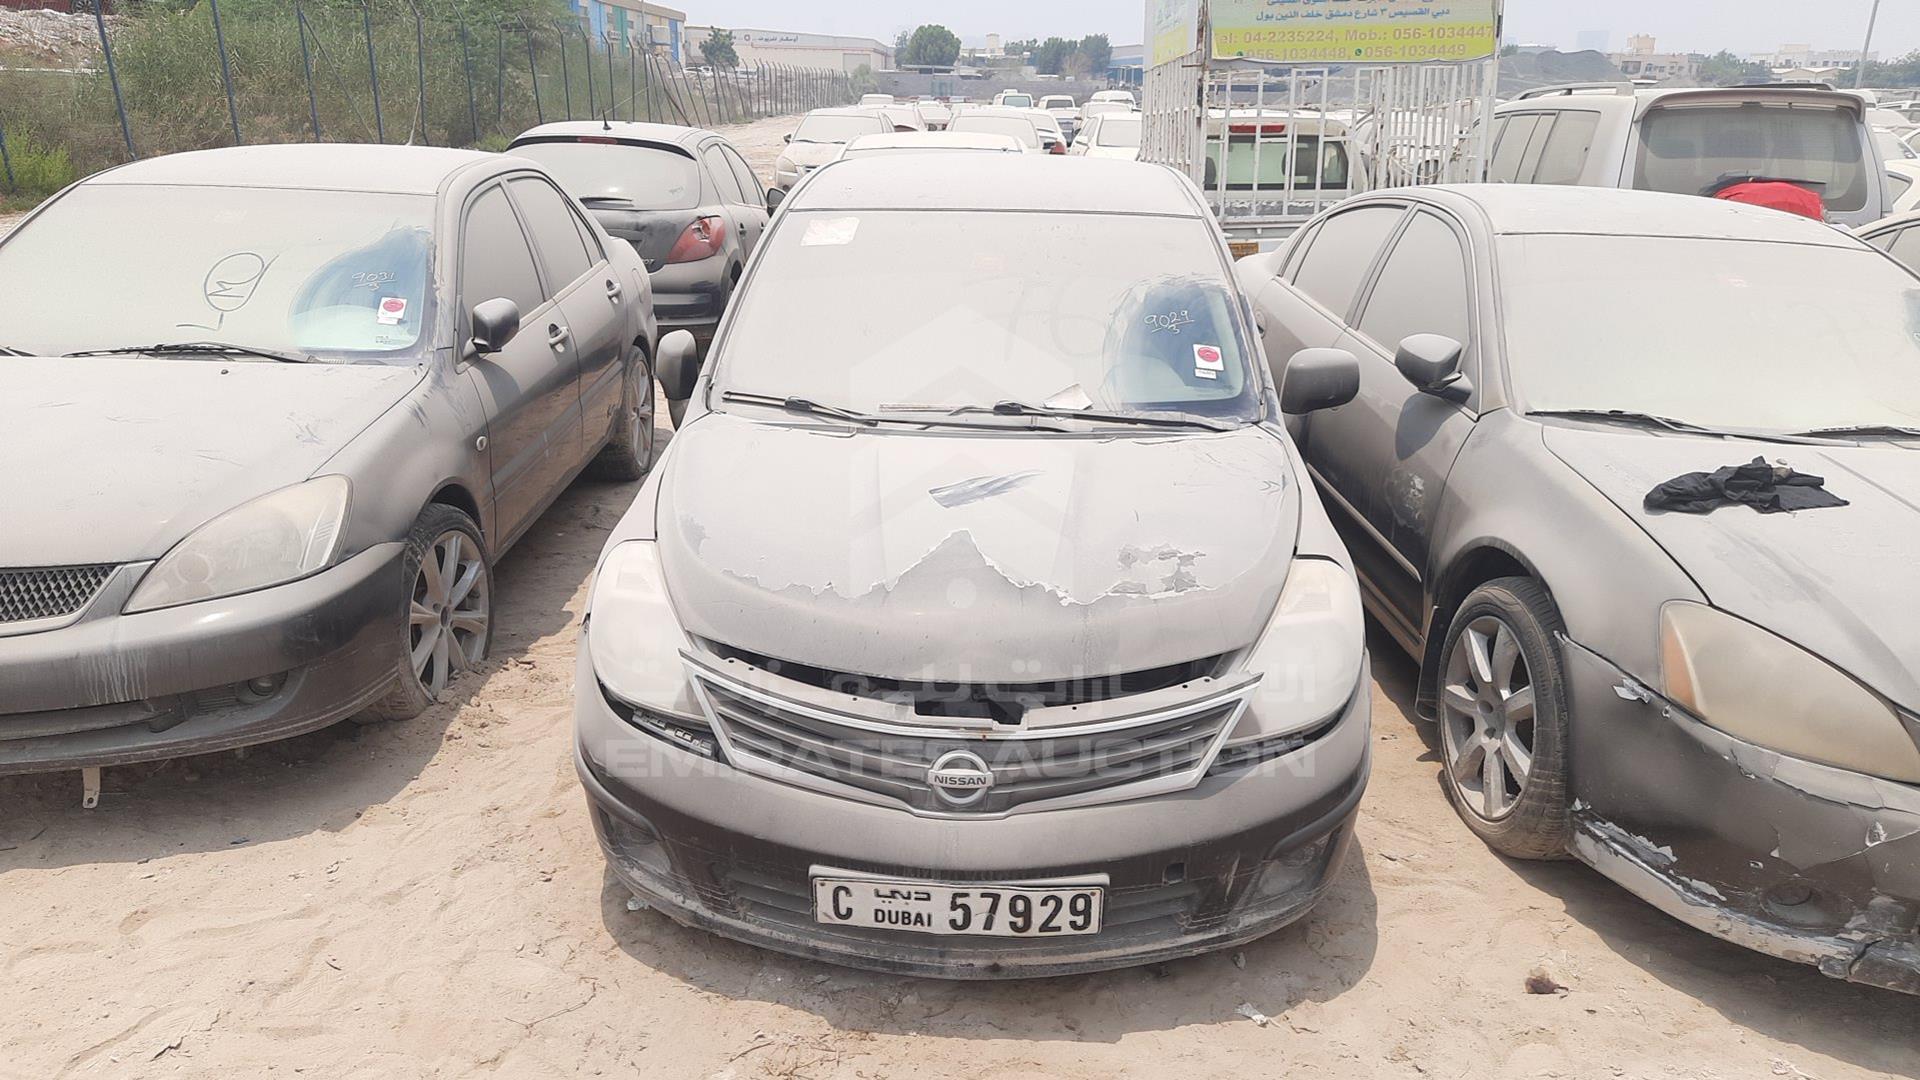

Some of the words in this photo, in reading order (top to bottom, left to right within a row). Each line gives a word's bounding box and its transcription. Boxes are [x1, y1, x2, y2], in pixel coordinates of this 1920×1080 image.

[1143, 310, 1190, 328] 9029
[934, 775, 987, 786] NISSAN
[832, 885, 853, 920] C
[948, 891, 1093, 933] 57929
[873, 908, 932, 927] DUBAI
